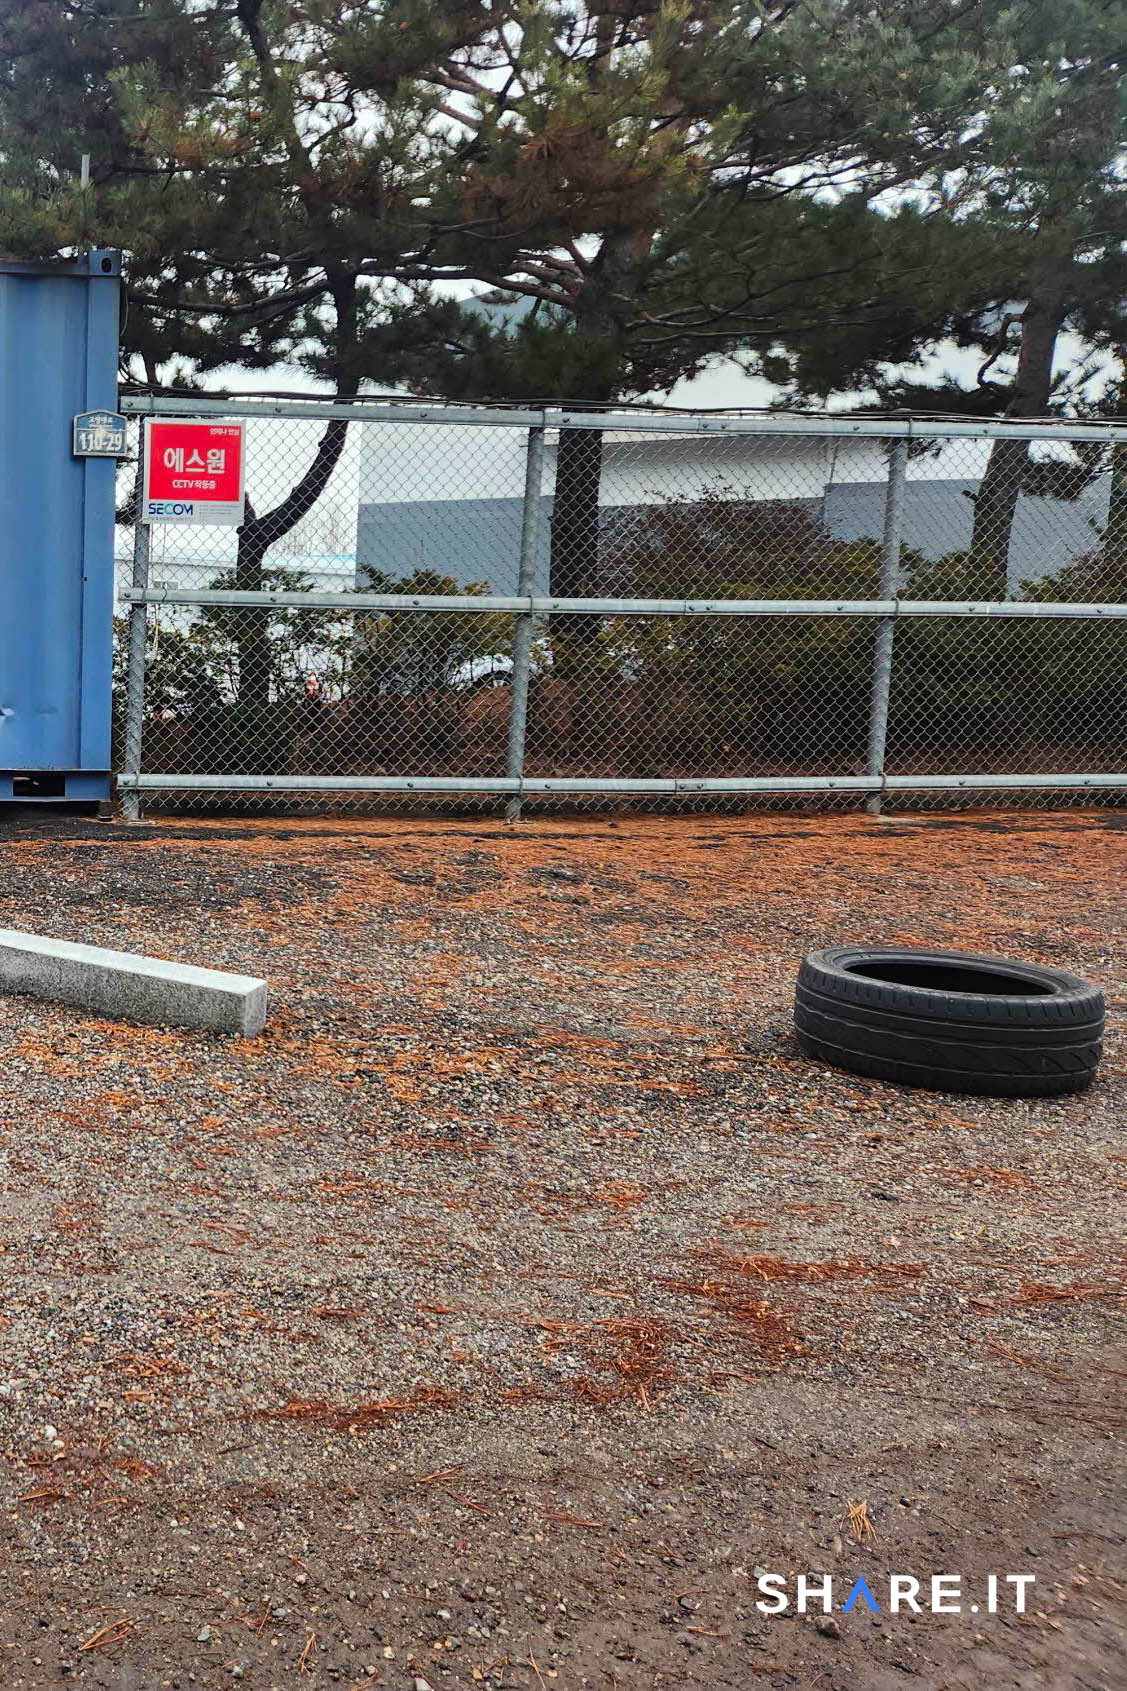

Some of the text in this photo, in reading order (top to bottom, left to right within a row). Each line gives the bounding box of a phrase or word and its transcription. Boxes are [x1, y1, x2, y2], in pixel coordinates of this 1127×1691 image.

[79, 431, 122, 451] 110-29
[163, 447, 225, 475] 에스원
[148, 503, 194, 515] SECOM
